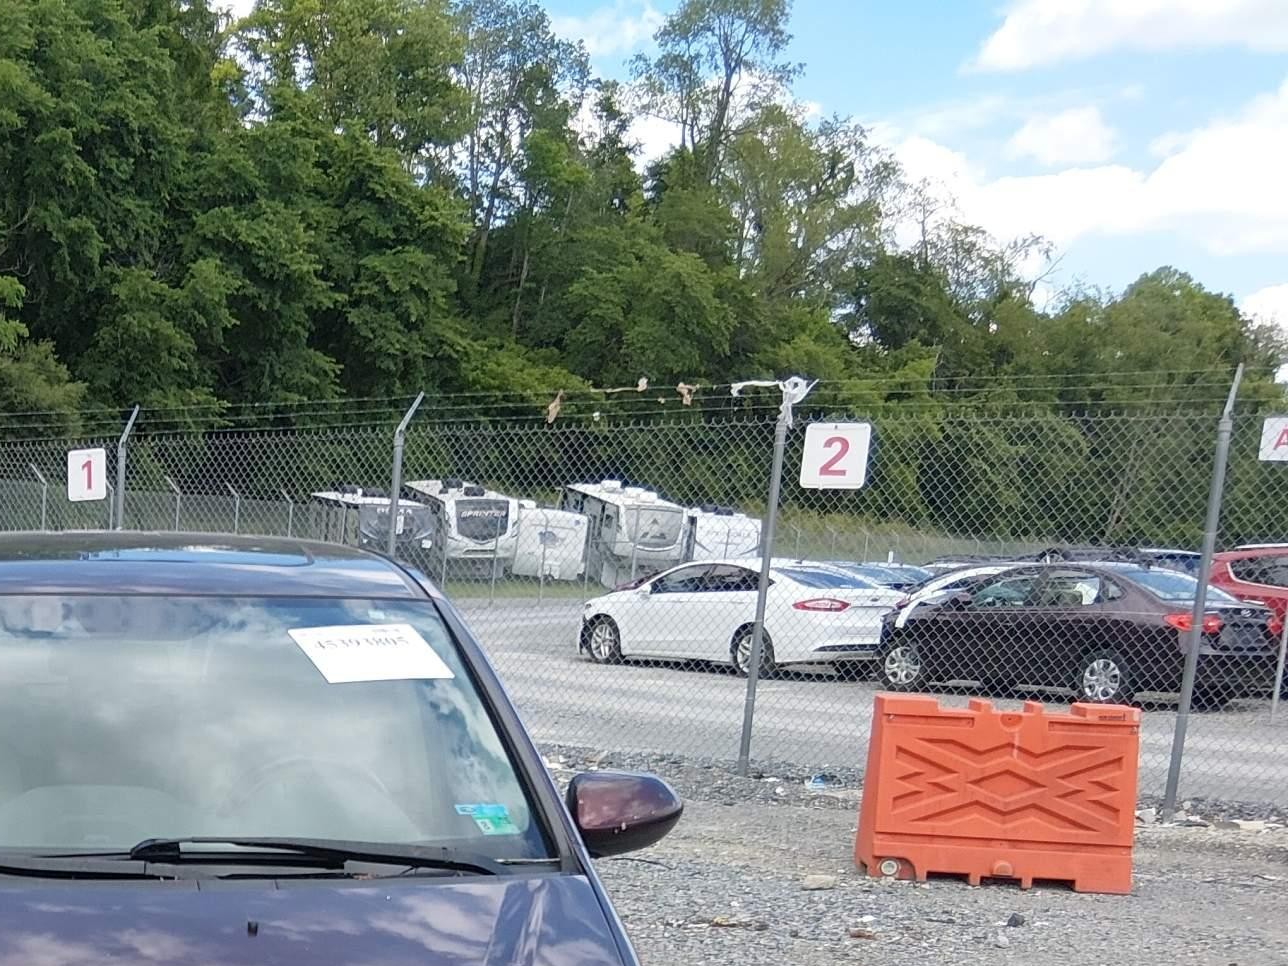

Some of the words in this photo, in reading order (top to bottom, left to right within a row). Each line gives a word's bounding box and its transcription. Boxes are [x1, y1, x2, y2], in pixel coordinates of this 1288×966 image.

[818, 436, 850, 477] 2
[81, 459, 92, 491] 1
[460, 510, 507, 518] SPRINTER
